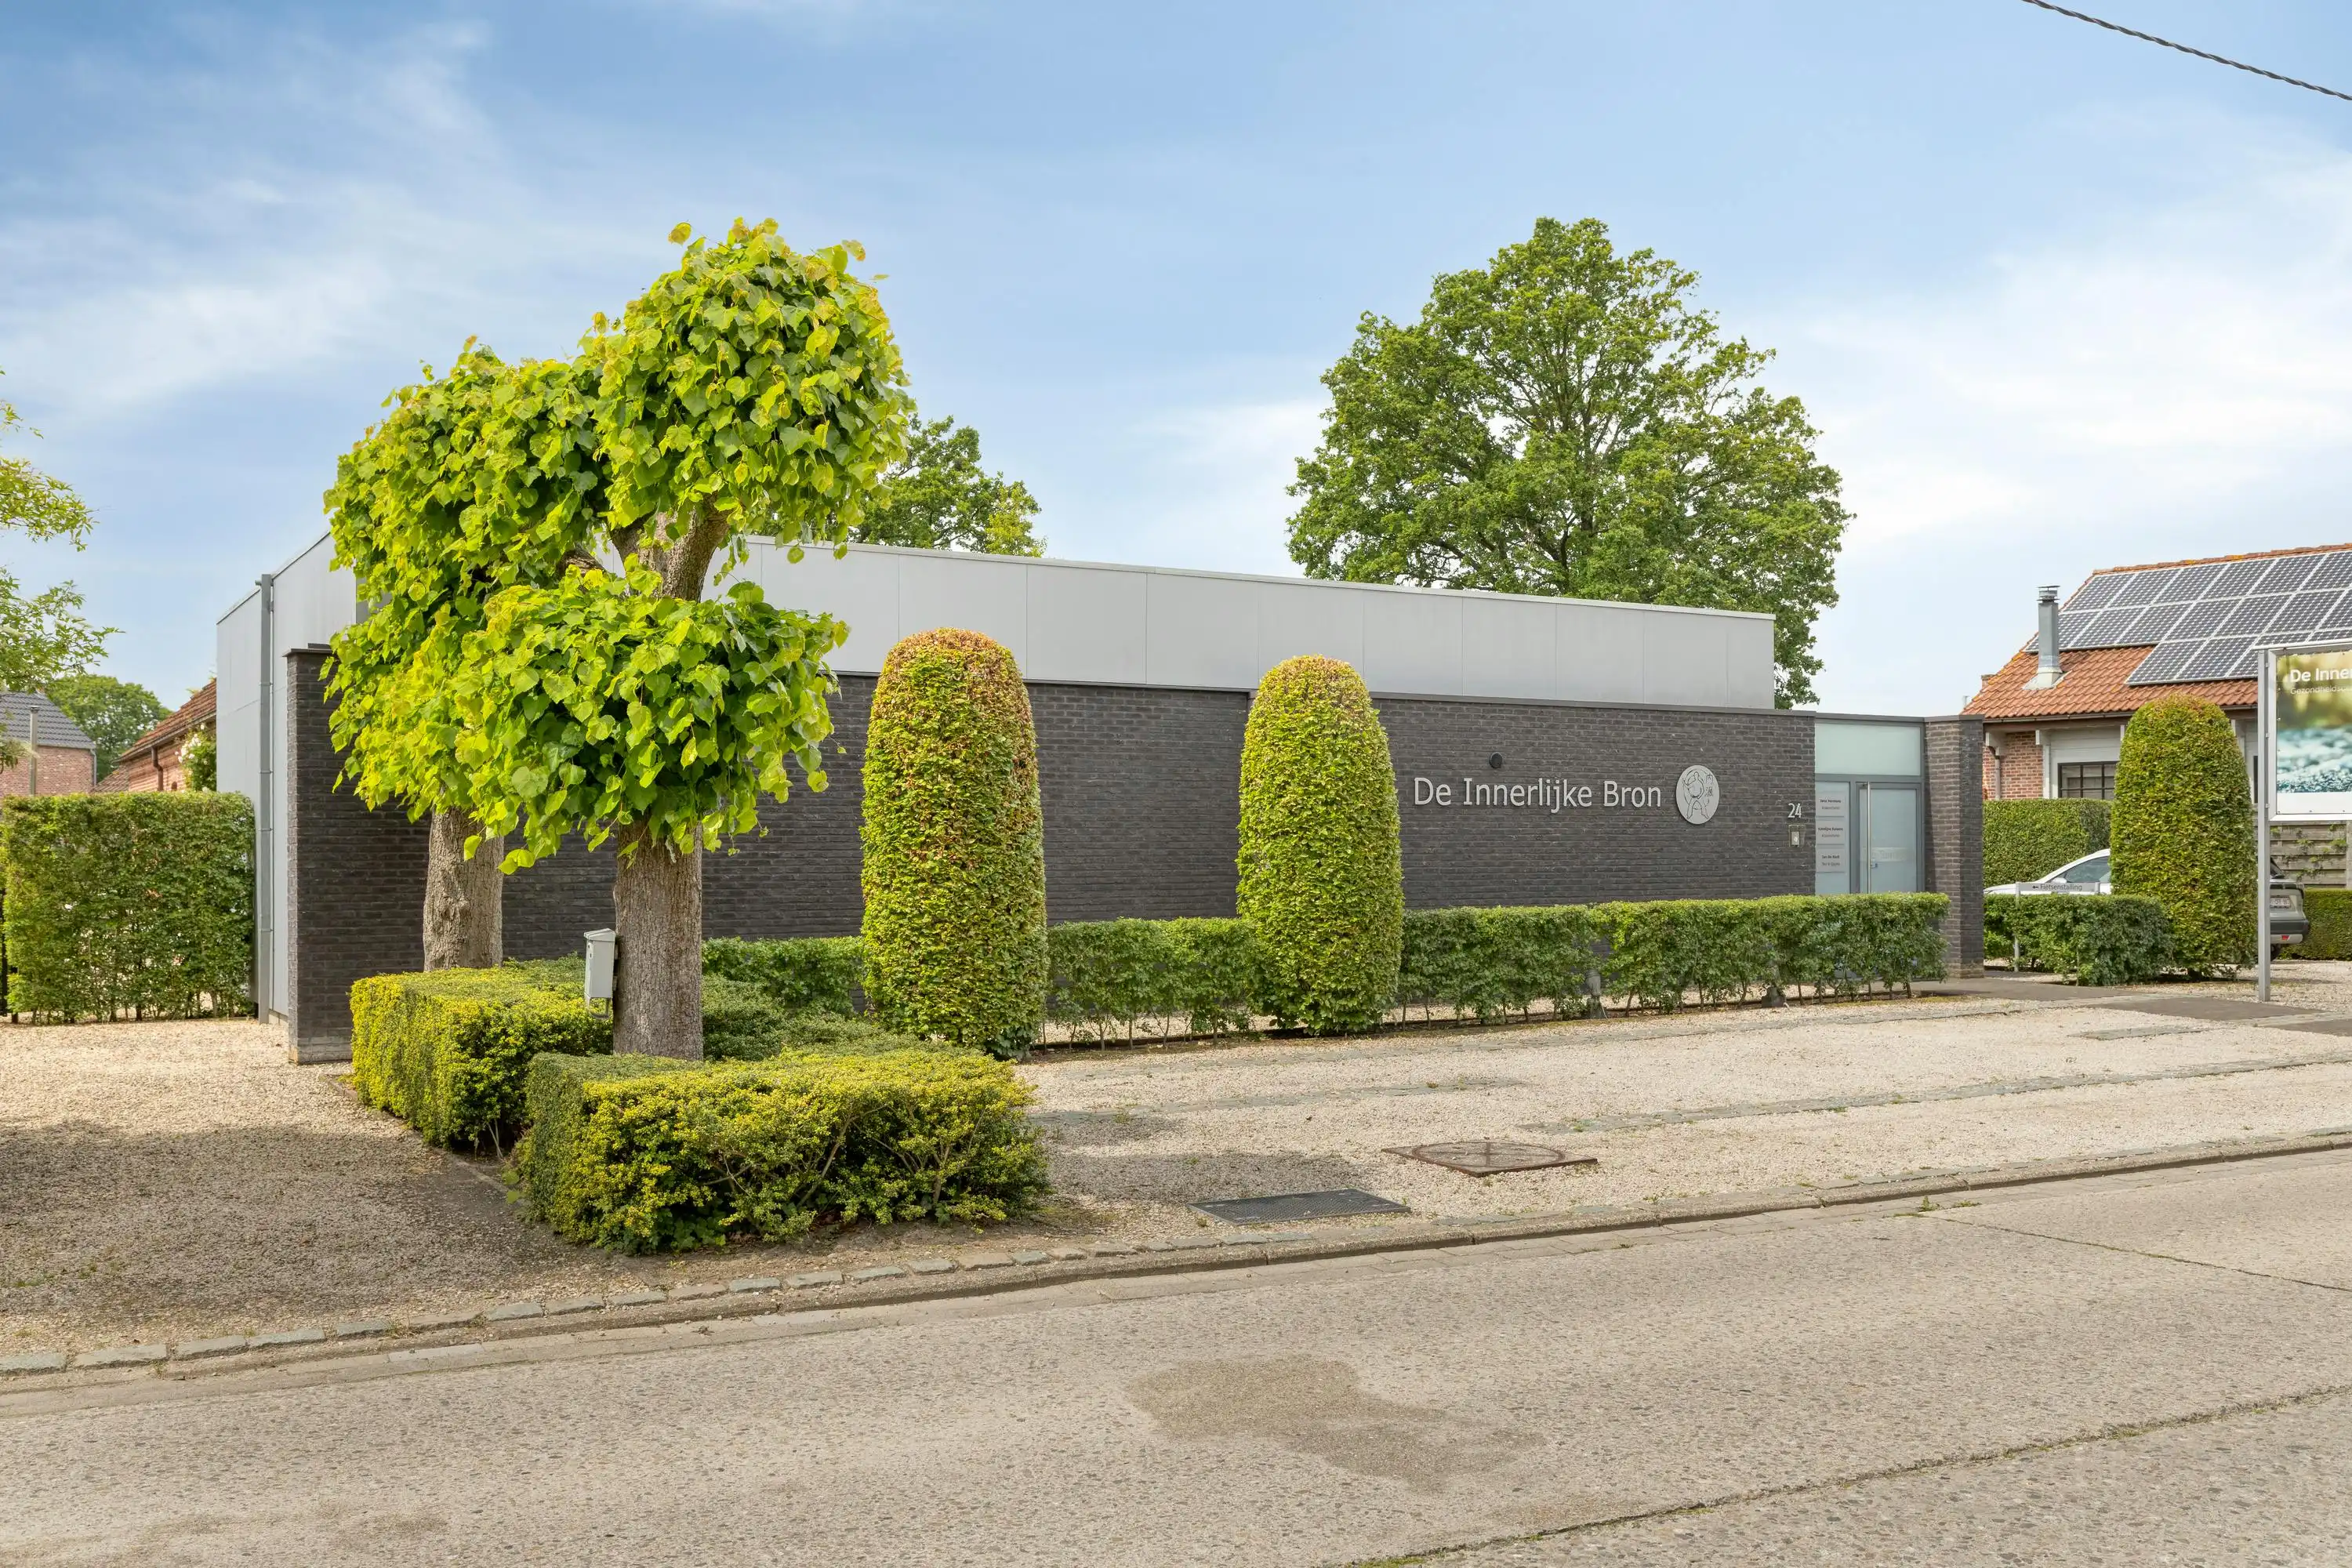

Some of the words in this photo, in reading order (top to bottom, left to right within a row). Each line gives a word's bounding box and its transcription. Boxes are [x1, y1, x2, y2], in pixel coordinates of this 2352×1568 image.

[2290, 669, 2311, 682] De
[1414, 777, 1451, 806] De
[1463, 778, 1592, 814] Innerlijke
[1603, 780, 1662, 808] Bron
[1788, 803, 1802, 818] 24
[2040, 883, 2083, 891] Fietsenstalling
